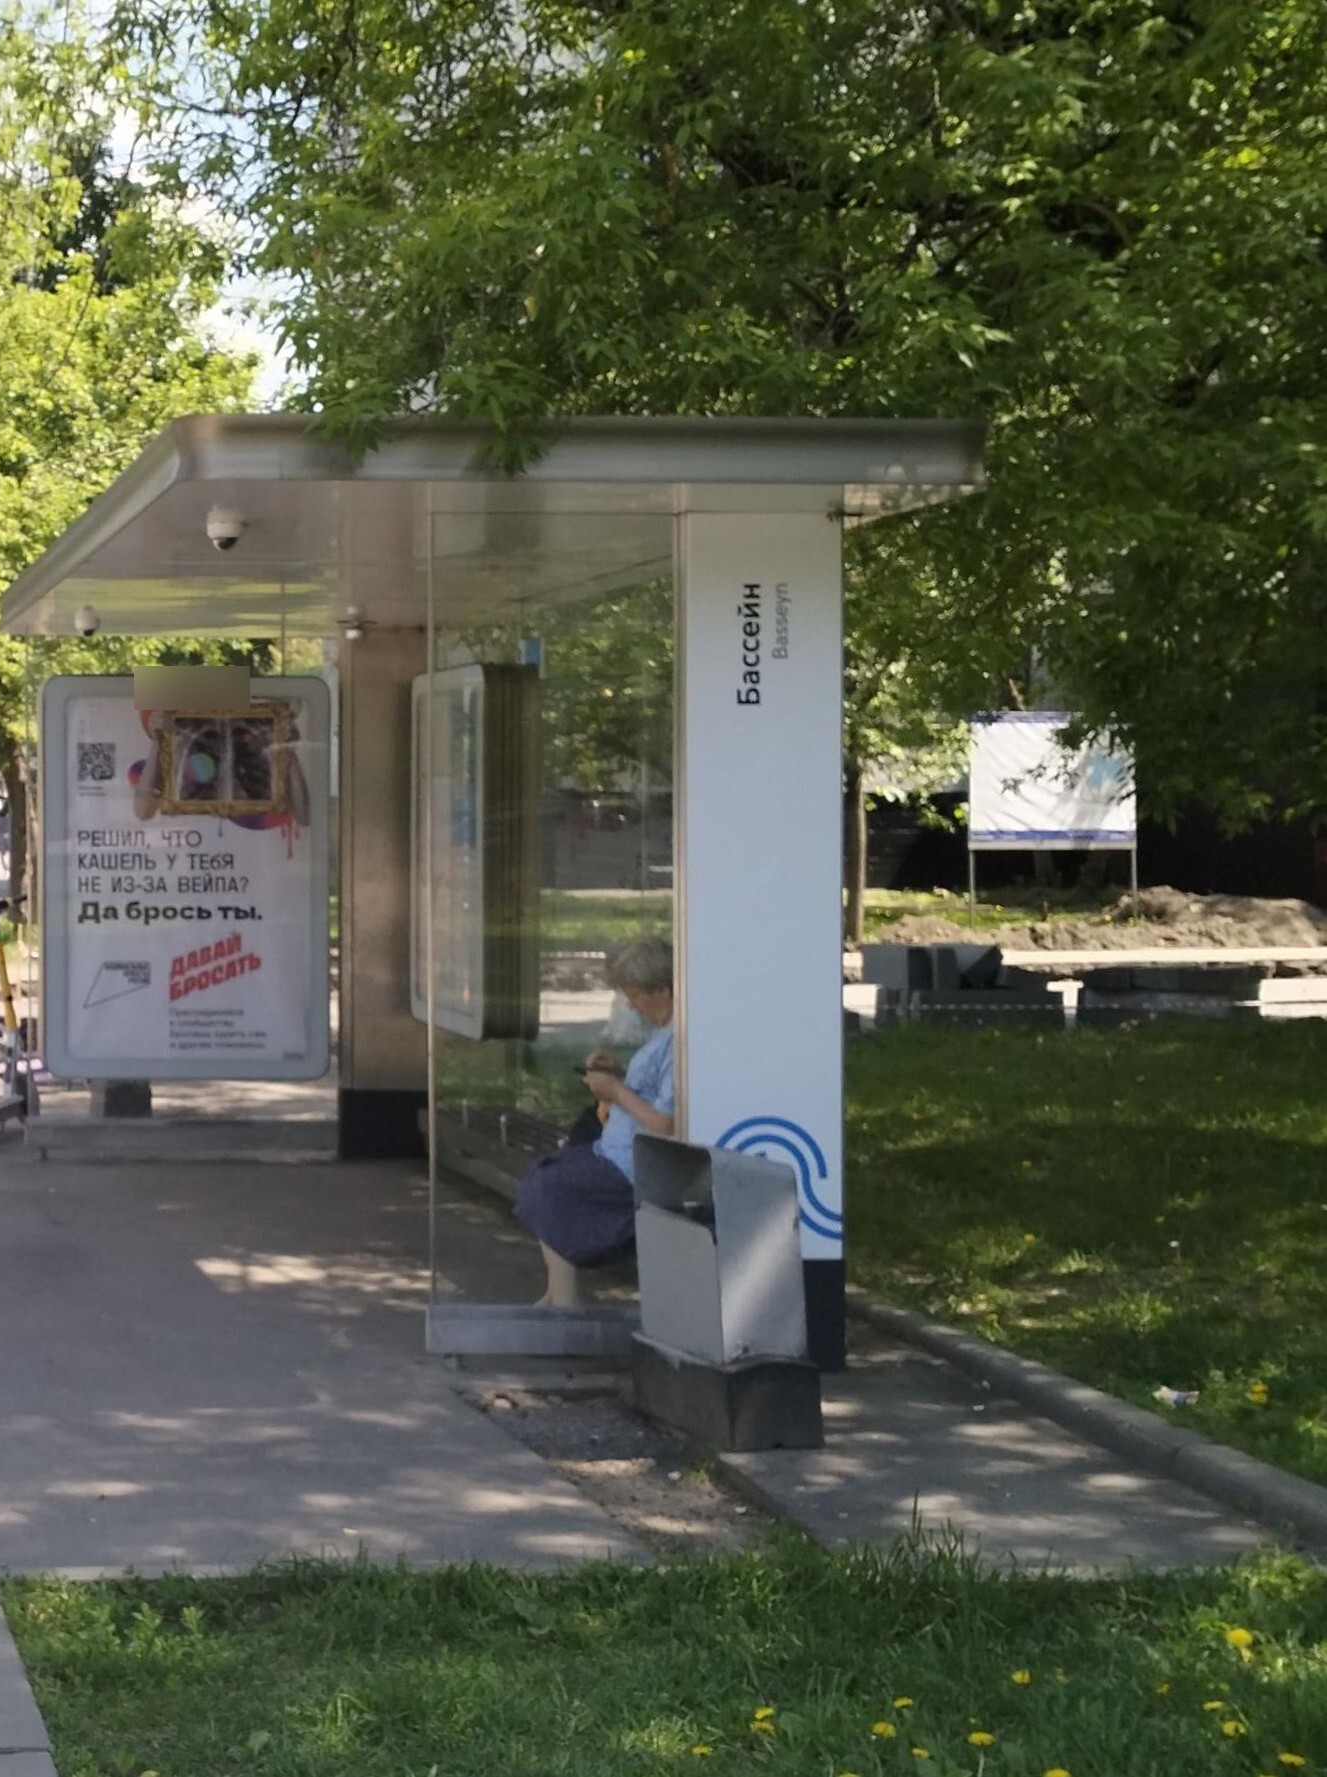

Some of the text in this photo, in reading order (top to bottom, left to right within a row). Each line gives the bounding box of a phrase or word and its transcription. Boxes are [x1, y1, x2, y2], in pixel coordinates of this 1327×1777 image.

[771, 582, 791, 659] Basseyn
[736, 582, 761, 706] Бассейн
[77, 829, 202, 849] РЕШИЛ, ЧТО
[77, 853, 157, 871] КАШЕЛЬ
[166, 853, 177, 871] У
[77, 872, 250, 893] НЕ ИЗ-ЗА ВЕЙПА?
[77, 901, 263, 925] Да брось ты.
[170, 931, 243, 977] ДАВАЙ
[169, 952, 262, 1003] БРОСАТЬ
